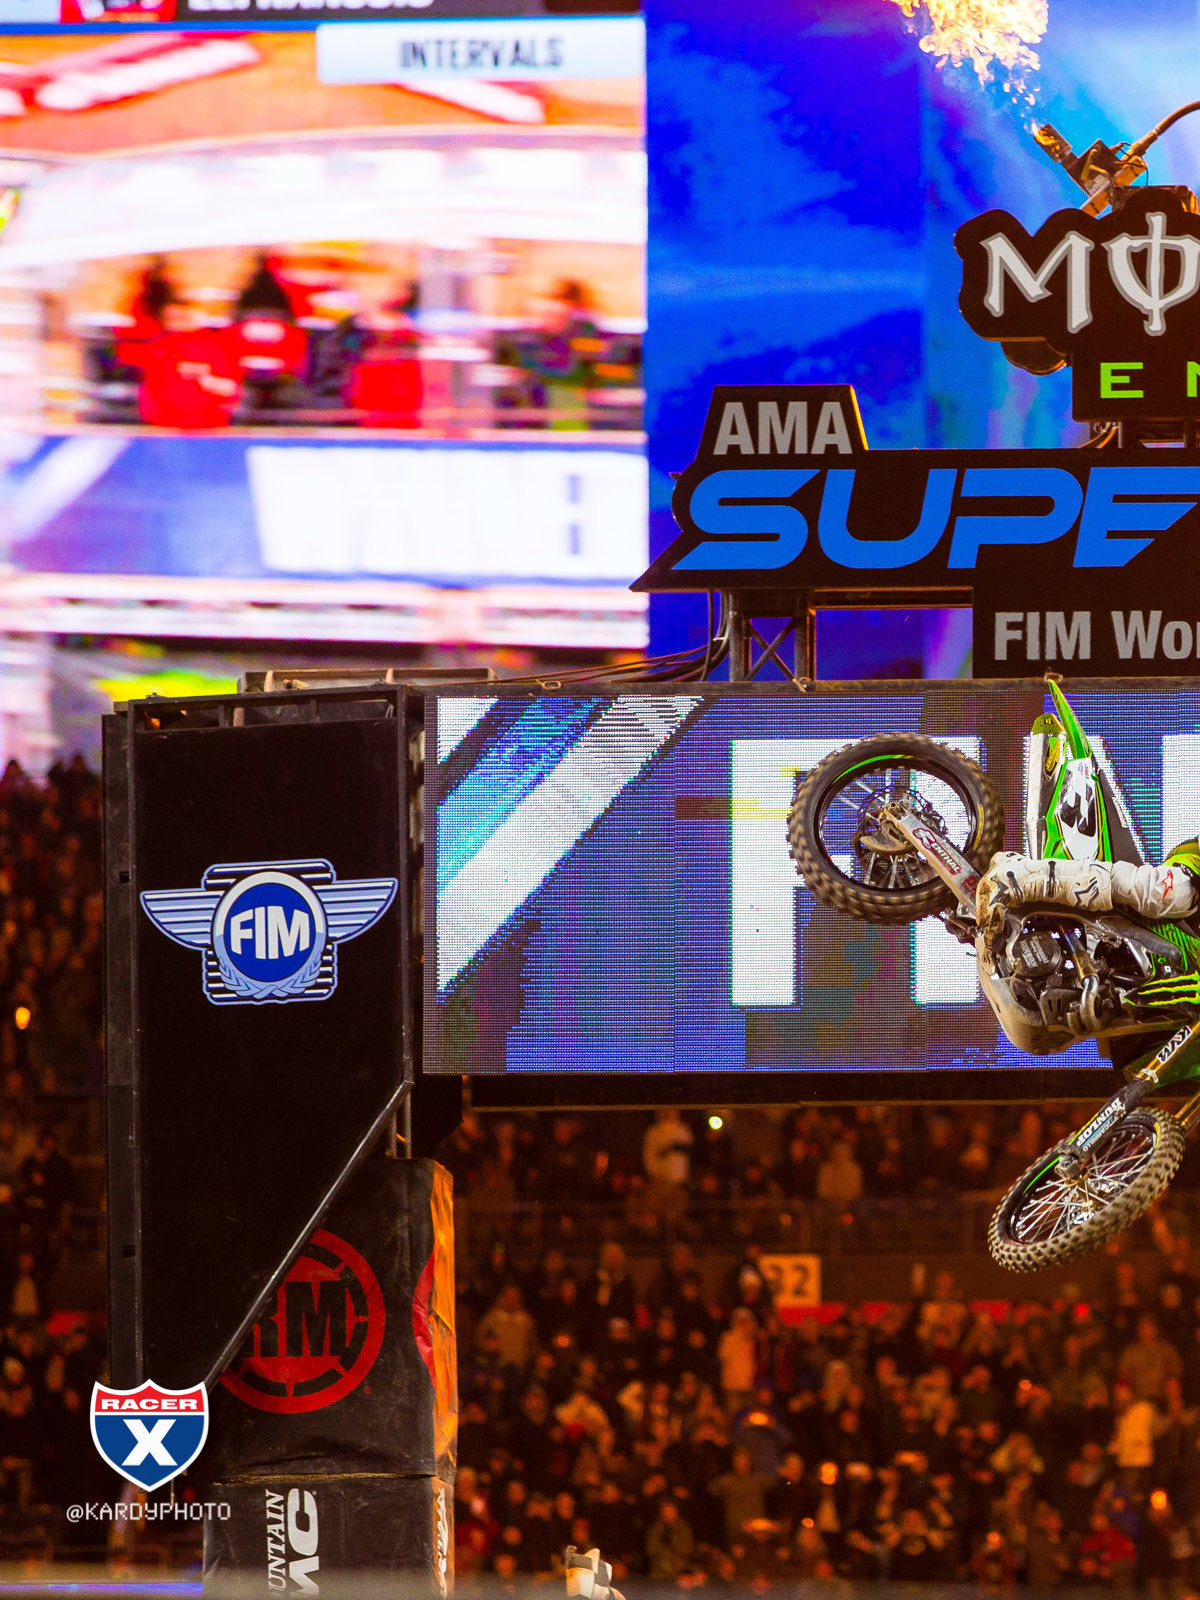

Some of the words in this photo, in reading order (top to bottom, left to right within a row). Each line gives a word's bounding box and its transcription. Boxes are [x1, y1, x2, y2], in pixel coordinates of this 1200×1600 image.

[401, 38, 563, 70] INTERVALS
[713, 401, 852, 455] AMA
[994, 611, 1092, 661] FIM
[914, 829, 962, 873] RENTHAL
[230, 905, 310, 959] FIM
[1076, 1097, 1121, 1147] DUNLOP
[266, 1489, 286, 1592] UNTAIN
